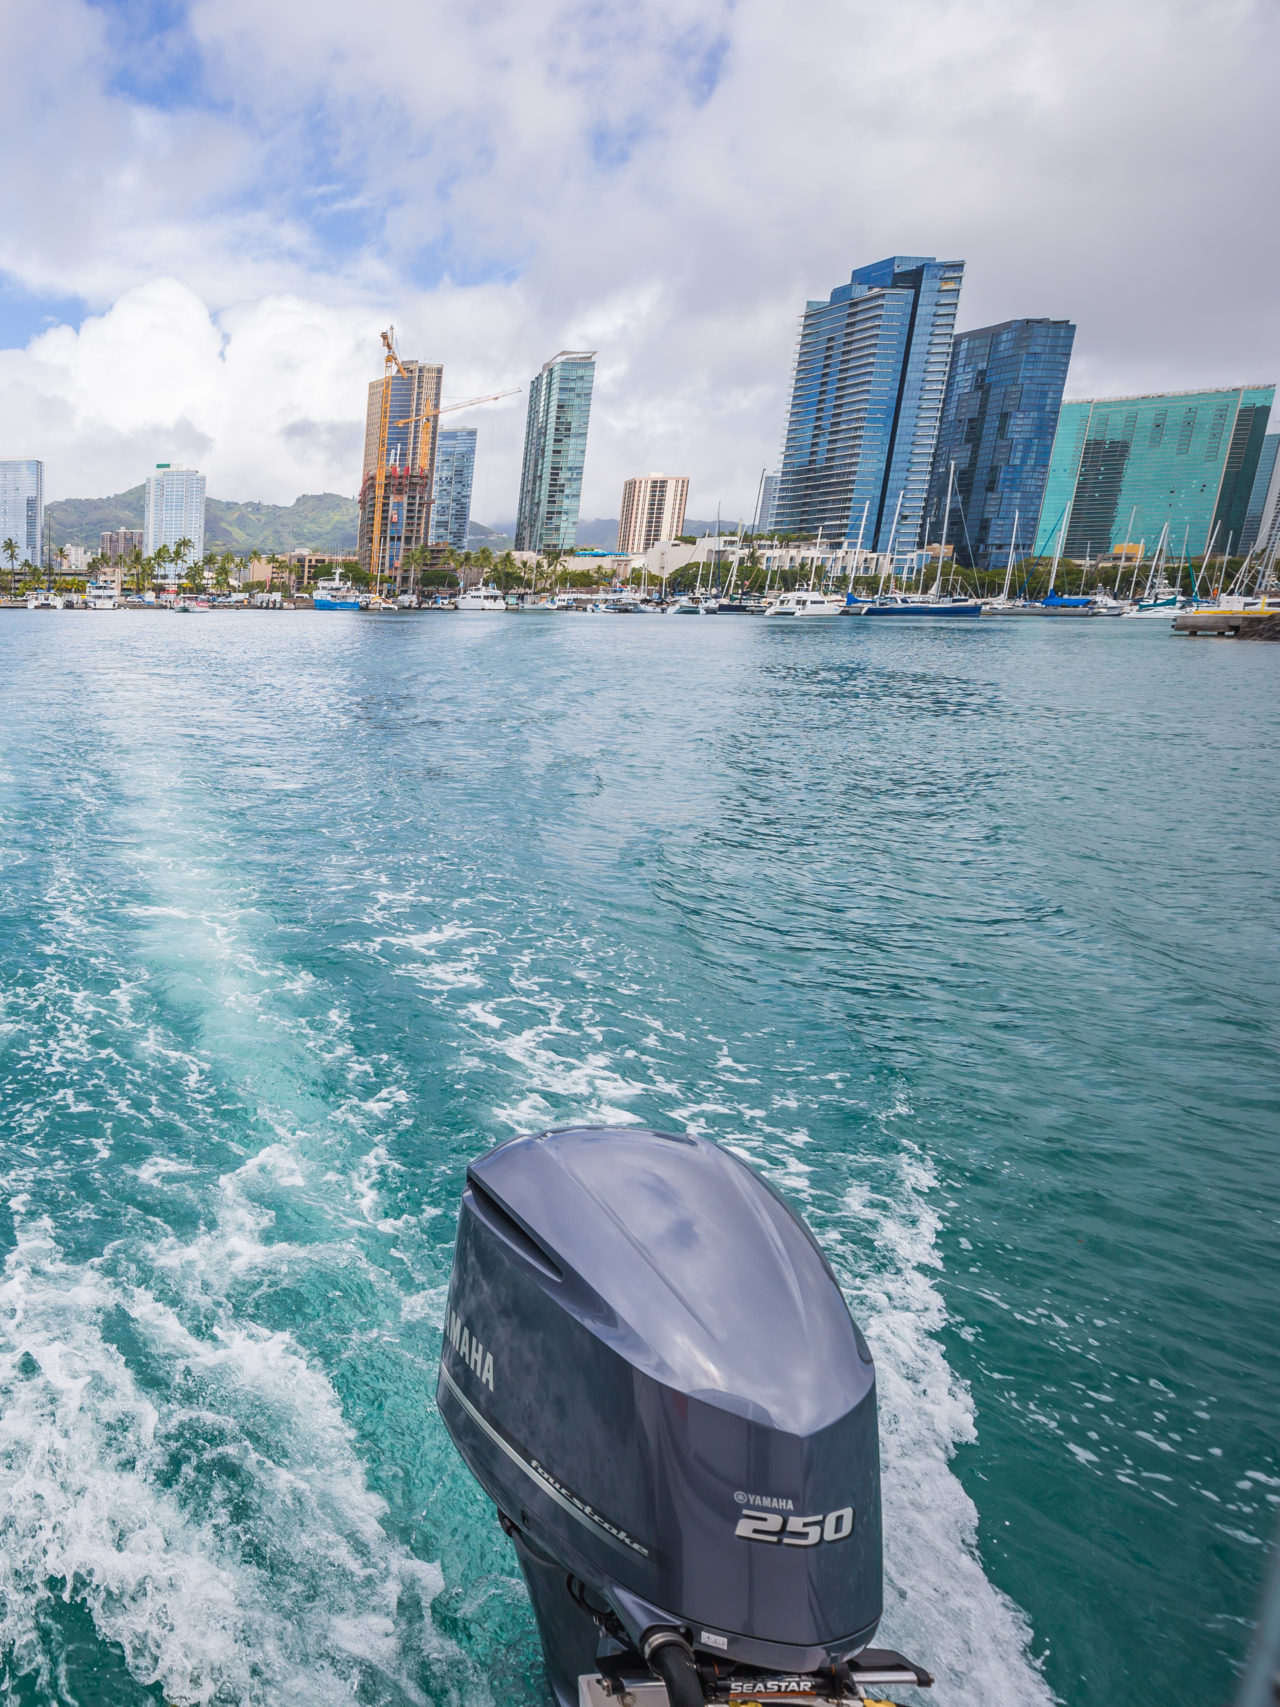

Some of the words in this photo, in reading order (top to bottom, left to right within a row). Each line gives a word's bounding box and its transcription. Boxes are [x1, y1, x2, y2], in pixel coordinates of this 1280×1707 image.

[748, 1494, 794, 1511] YAMAHA
[735, 1507, 854, 1546] 250
[730, 1681, 812, 1694] SEASTAR
